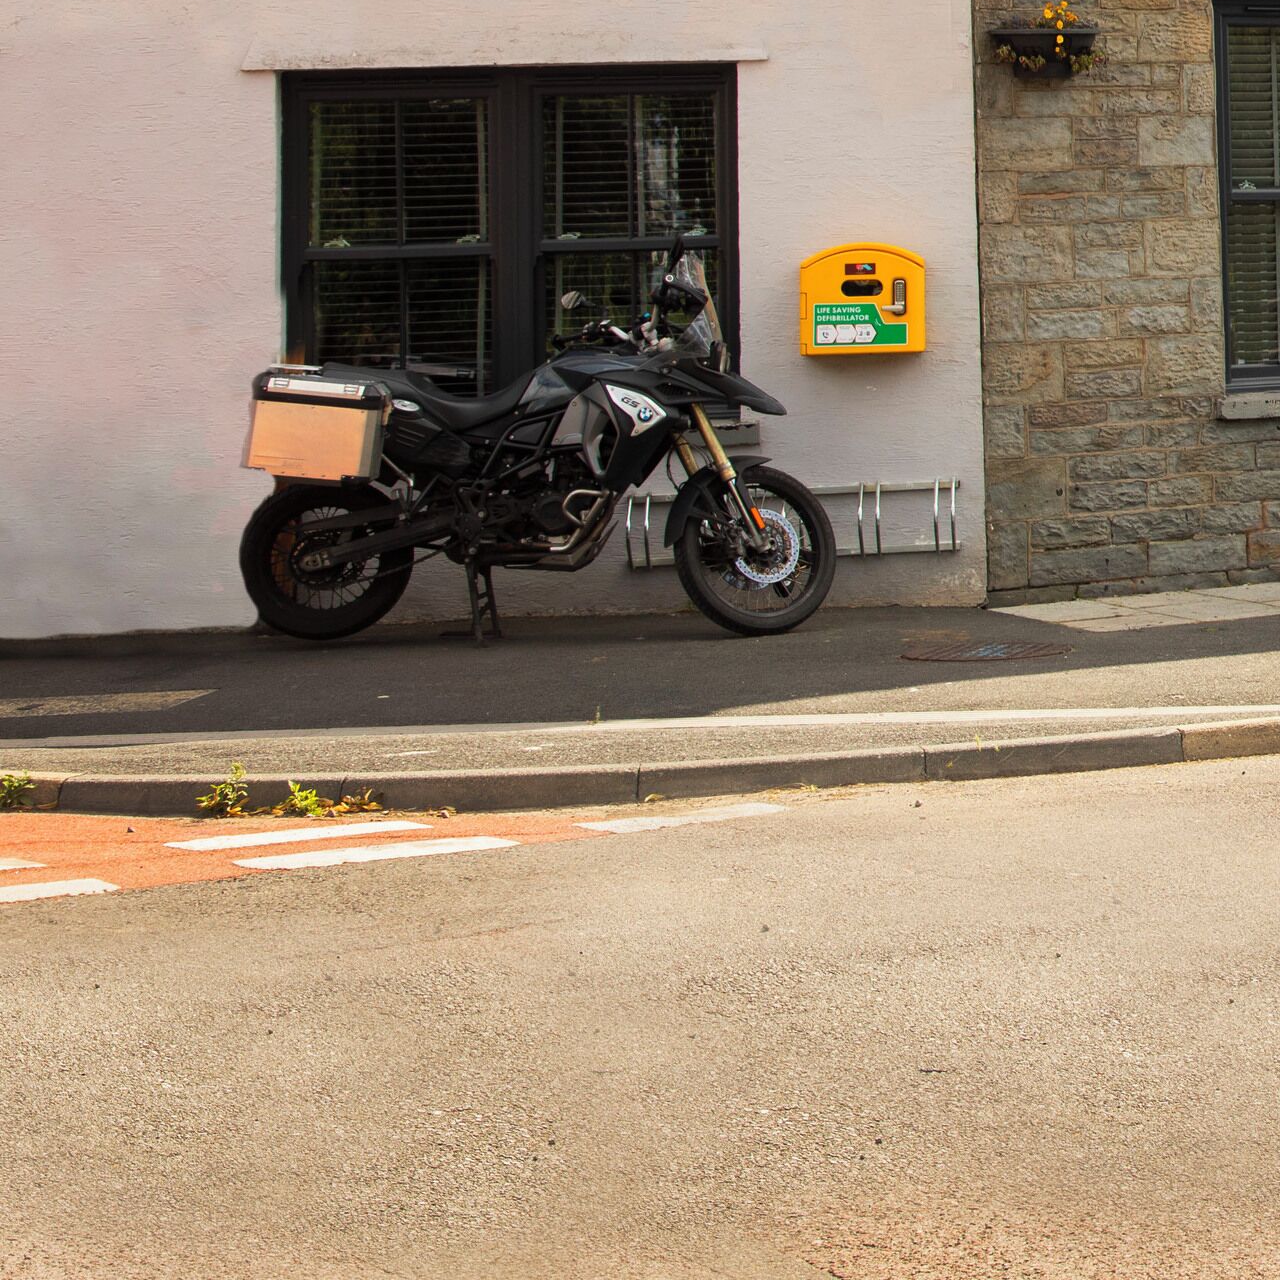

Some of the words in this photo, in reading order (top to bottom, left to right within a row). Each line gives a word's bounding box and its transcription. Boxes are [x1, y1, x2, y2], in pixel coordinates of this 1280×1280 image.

[816, 306, 831, 314] LIFE
[832, 306, 862, 314] SAVING
[816, 314, 870, 322] DEFIBRILLATOR
[621, 396, 641, 408] GS
